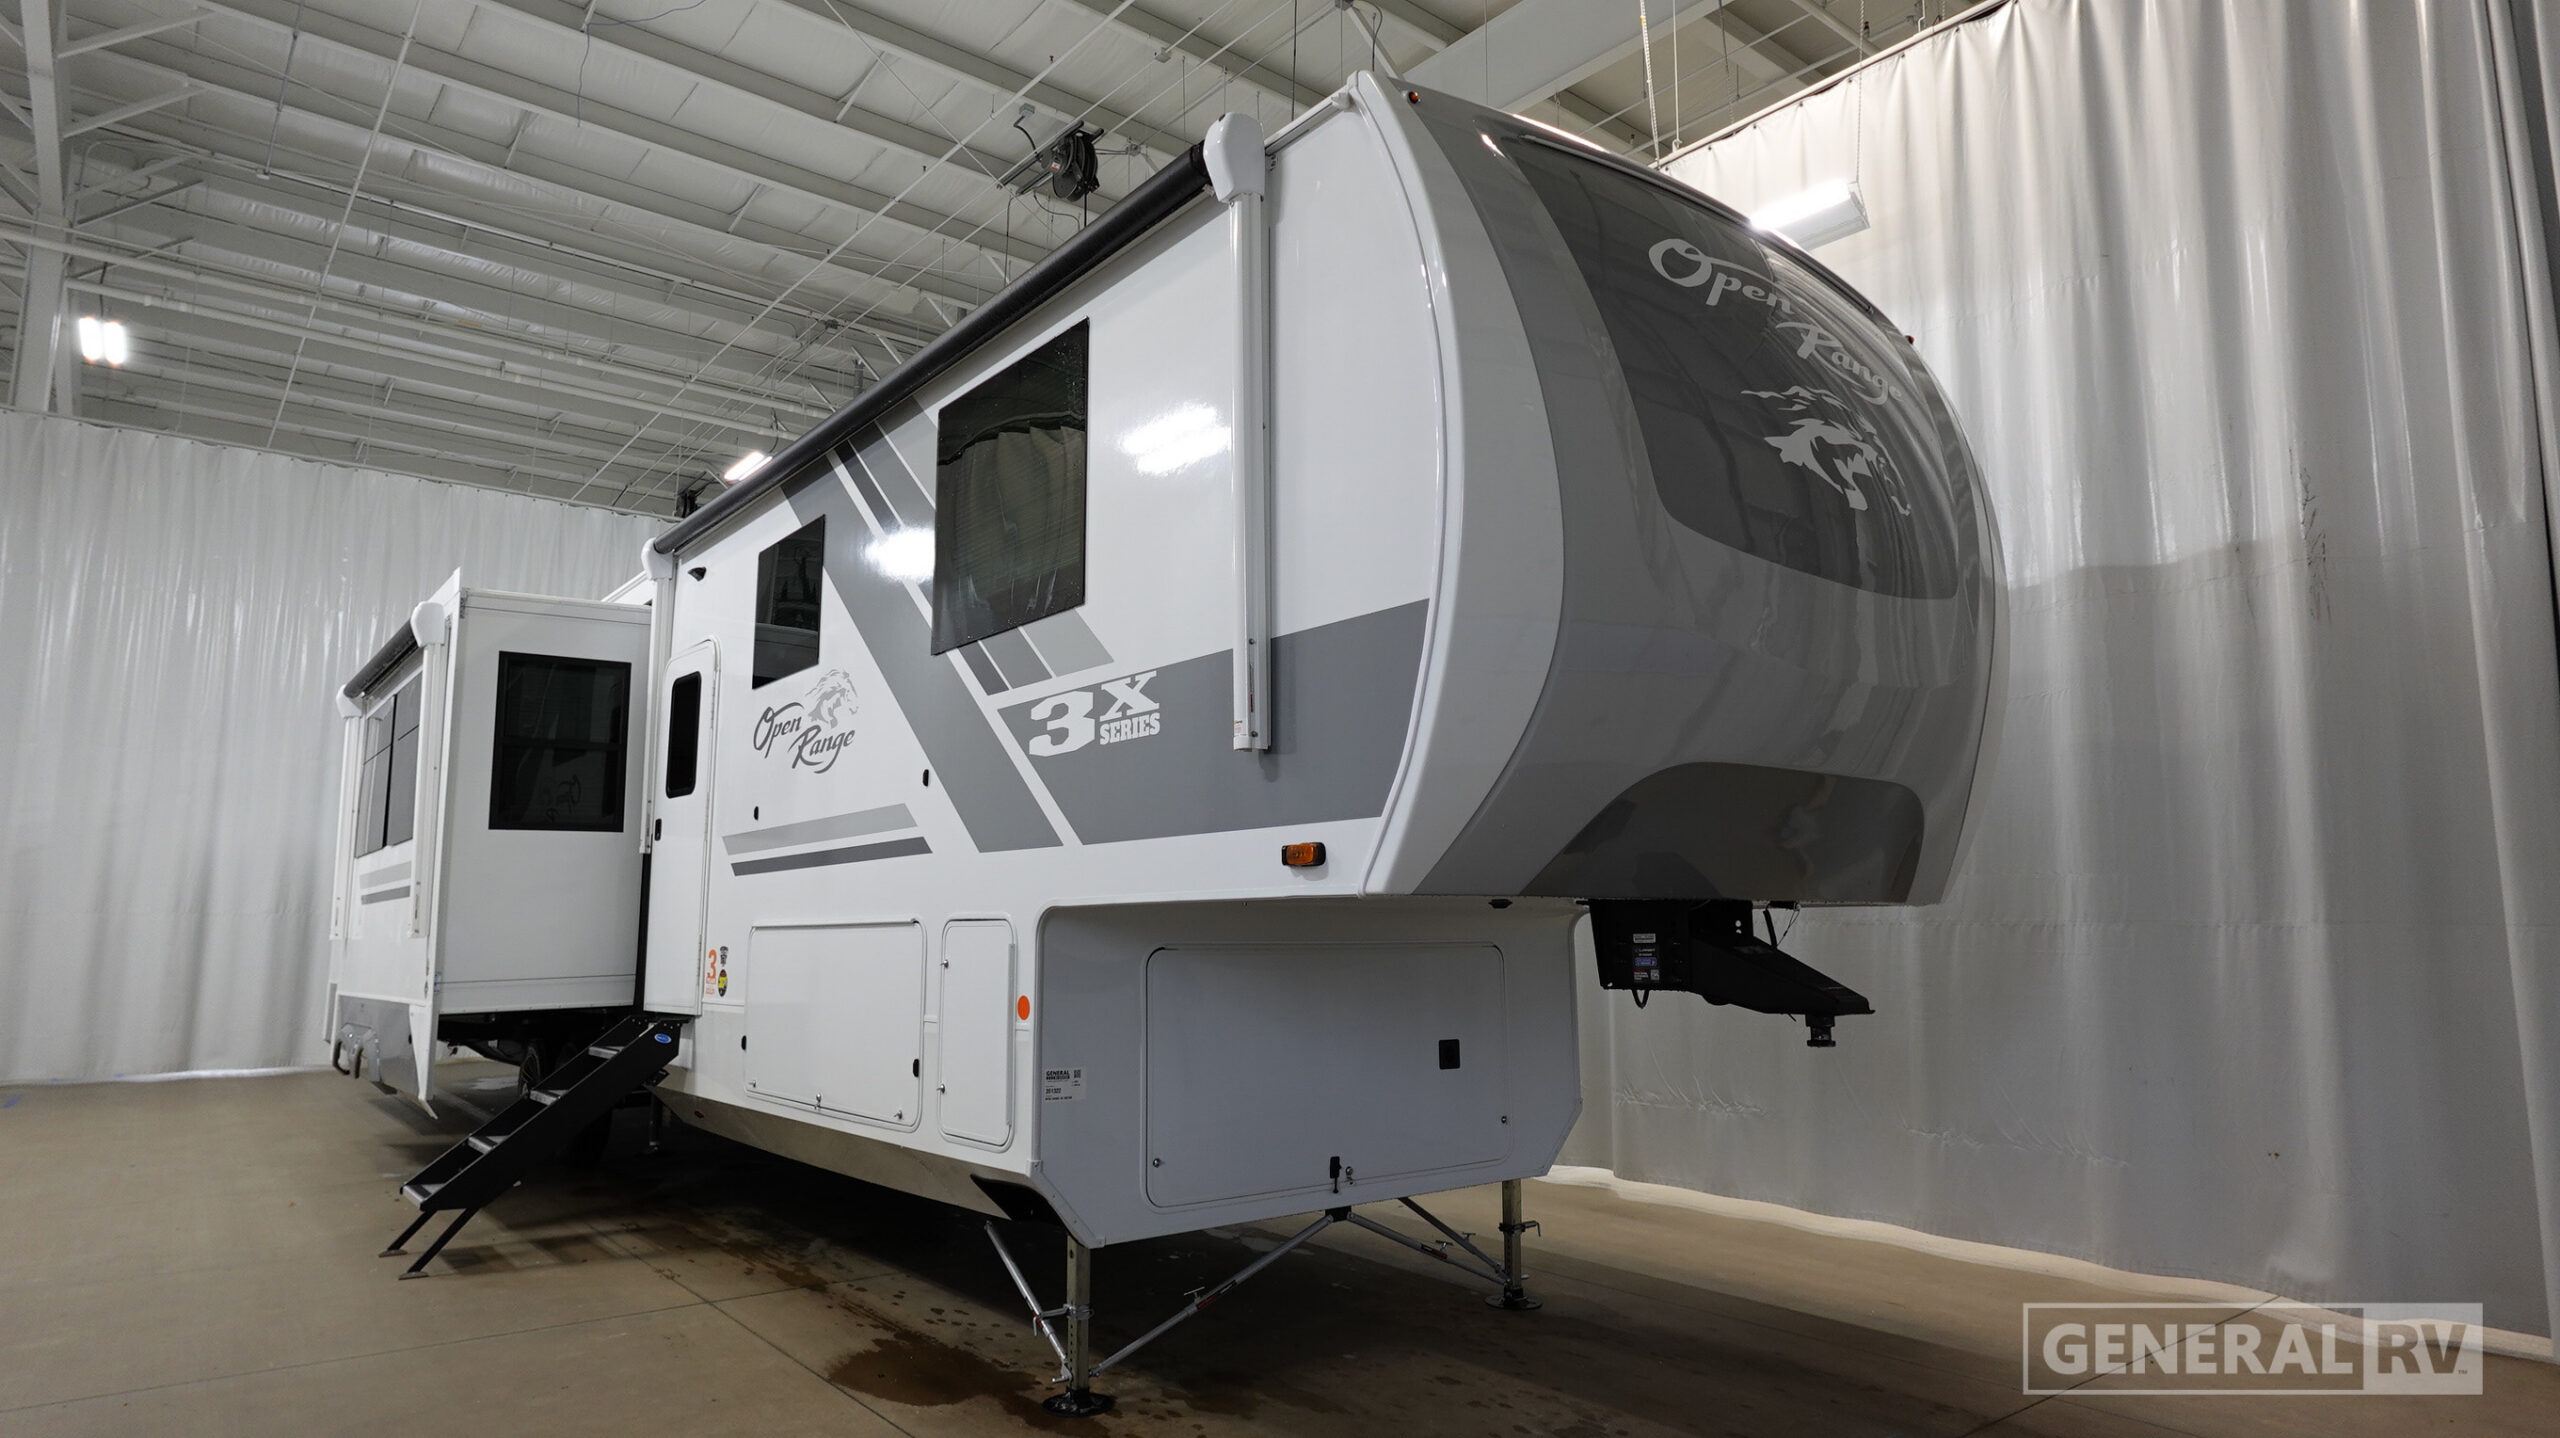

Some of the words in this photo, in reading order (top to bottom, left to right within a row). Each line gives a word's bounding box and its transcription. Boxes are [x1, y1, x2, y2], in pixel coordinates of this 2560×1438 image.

[1649, 238, 1798, 315] Open
[1776, 322, 1901, 405] Range
[753, 702, 804, 759] Open
[787, 724, 855, 774] Range
[1100, 712, 1160, 745] SERIES
